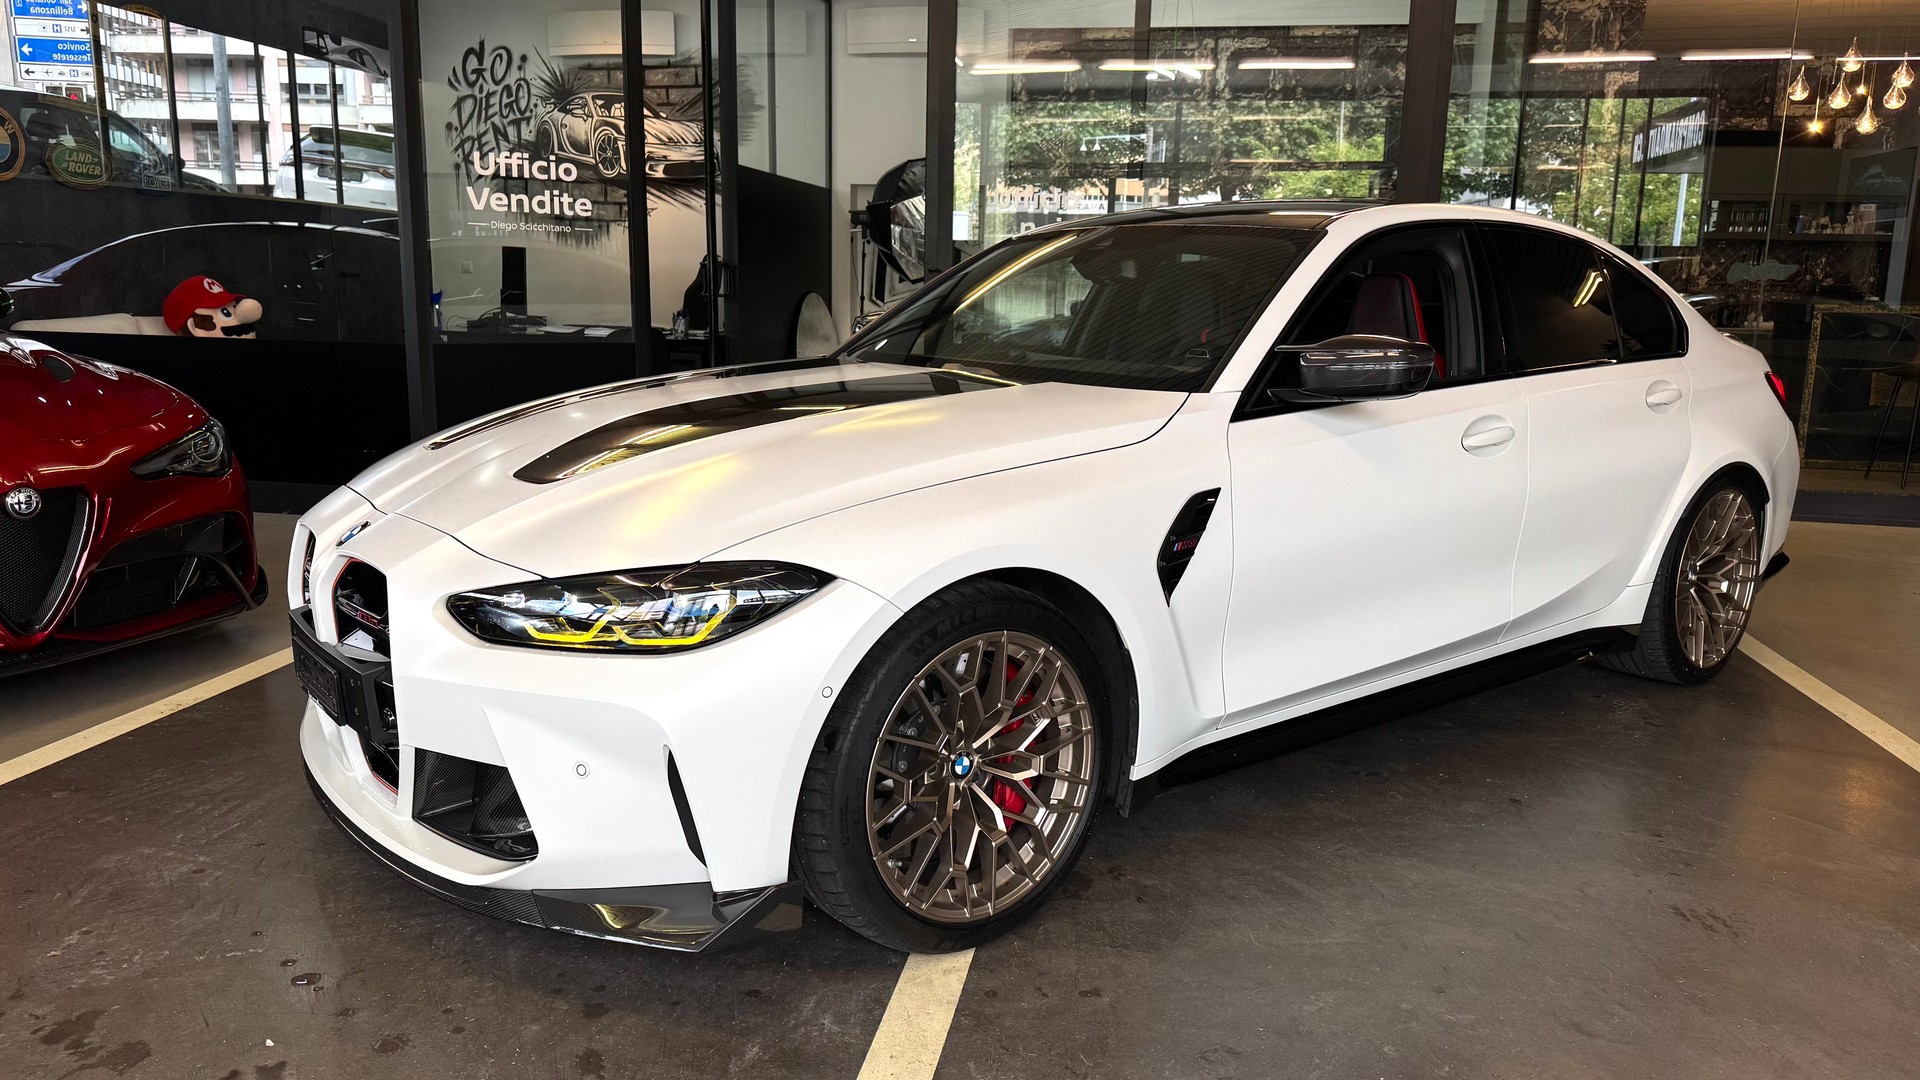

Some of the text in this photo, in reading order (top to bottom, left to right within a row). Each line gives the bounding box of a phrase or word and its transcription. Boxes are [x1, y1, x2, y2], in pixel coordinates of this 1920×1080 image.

[461, 37, 513, 88] GO
[65, 150, 92, 163] LAND
[451, 116, 533, 181] RENT
[68, 162, 102, 176] ROVER
[473, 150, 578, 182] Ufficio
[466, 186, 593, 217] Vendite
[490, 221, 572, 233] Diego Scicchitano
